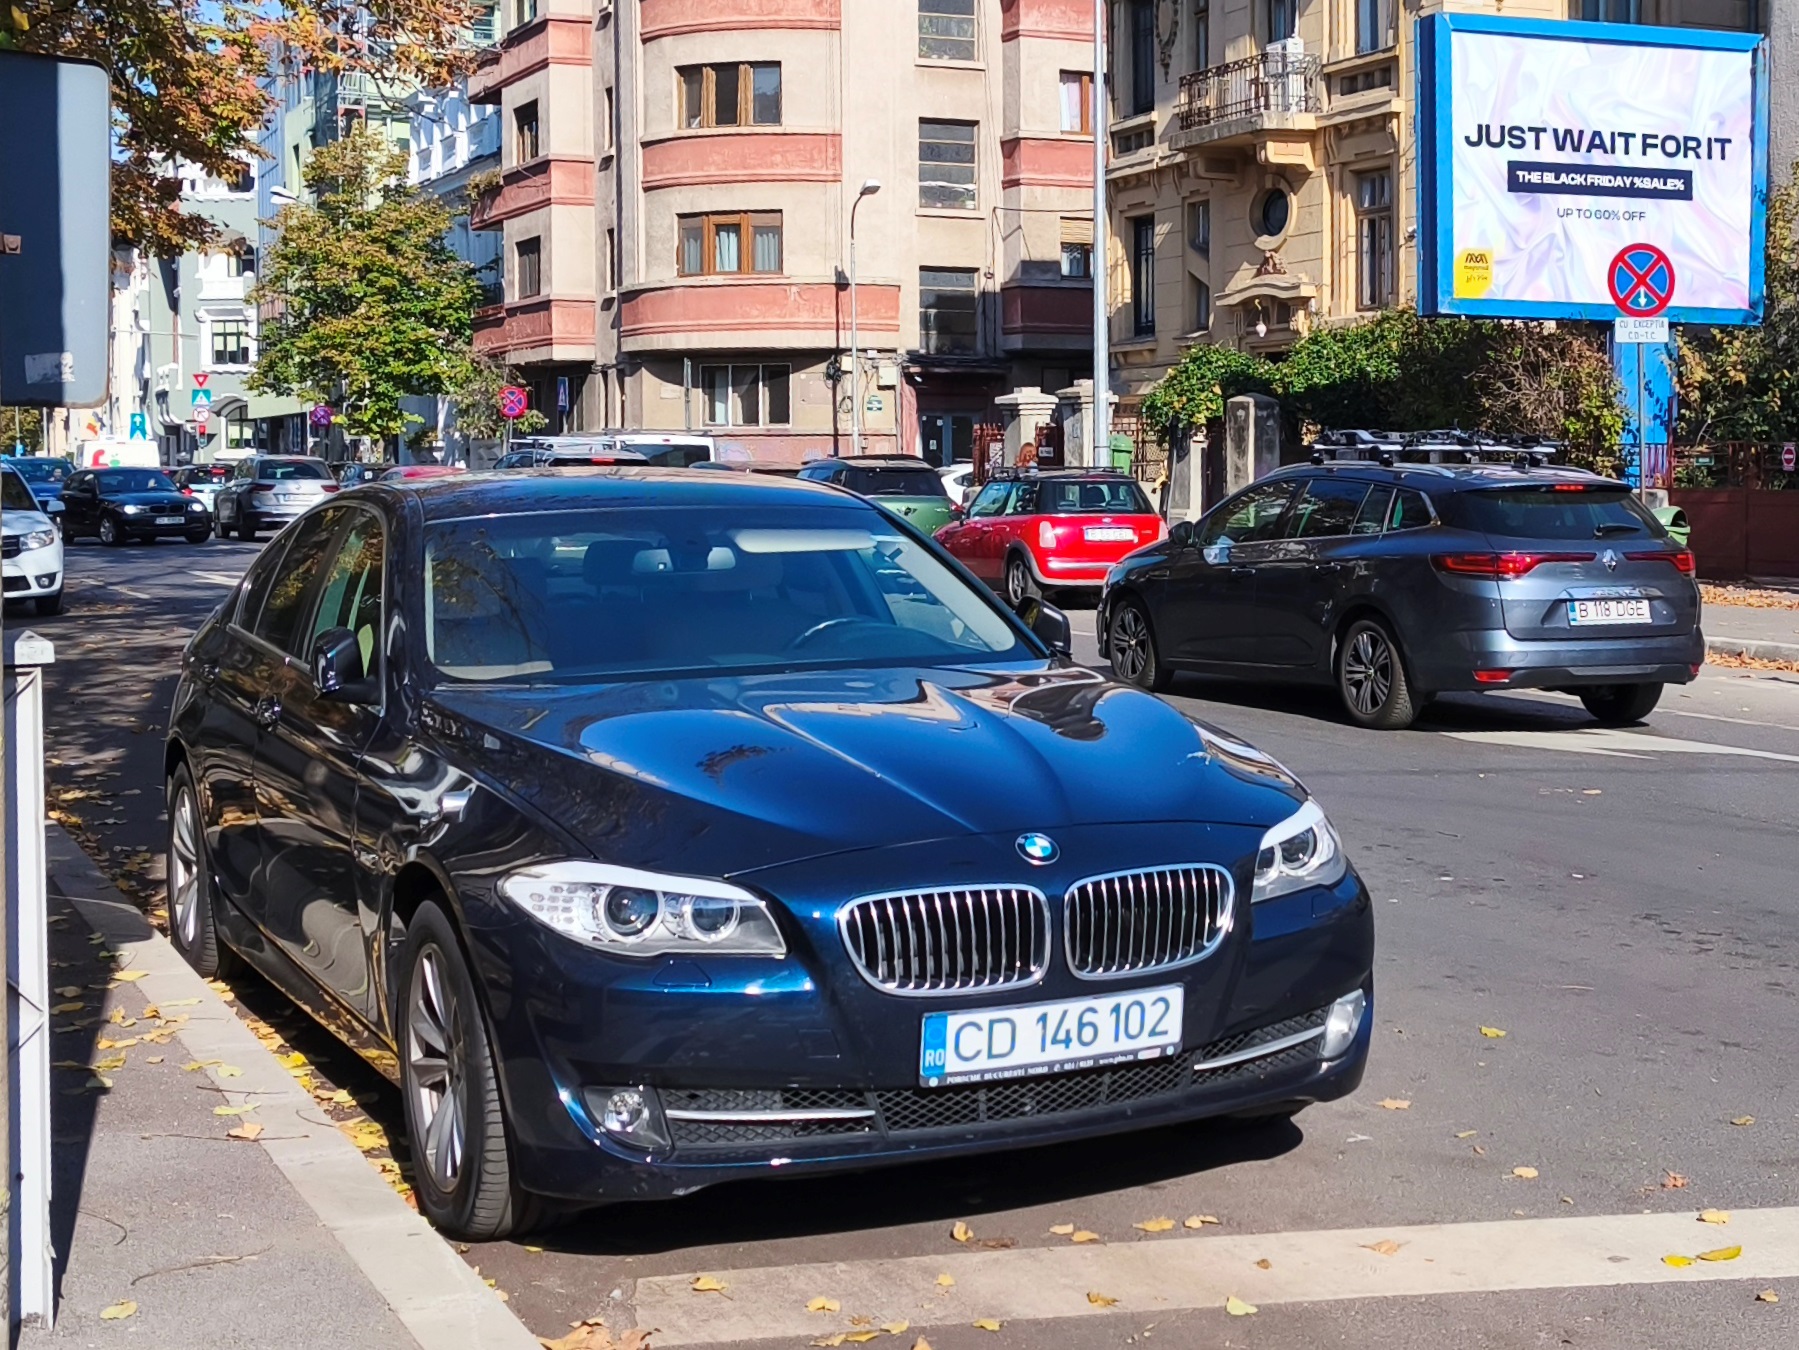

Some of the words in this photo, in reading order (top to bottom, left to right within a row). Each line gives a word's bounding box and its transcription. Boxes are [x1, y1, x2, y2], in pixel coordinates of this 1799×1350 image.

[1464, 123, 1547, 150] JUST
[1553, 128, 1636, 156] WAIT
[1641, 134, 1701, 160] FOR
[1706, 137, 1732, 161] IT
[1516, 170, 1542, 183] THE
[1543, 172, 1586, 186] BLACK
[1587, 174, 1632, 189] FRIDAY
[1633, 176, 1685, 191] %SALE%
[1556, 207, 1574, 219] UP
[1575, 208, 1592, 220] TO
[1594, 208, 1620, 221] 60%
[1622, 209, 1646, 222] OFF
[1579, 603, 1588, 618] B
[1594, 600, 1611, 617] 118
[1616, 600, 1645, 616] DGE
[954, 1017, 1017, 1062] CD
[1036, 1007, 1099, 1053] 146
[1109, 996, 1171, 1043] 102
[924, 1048, 945, 1068] RO
